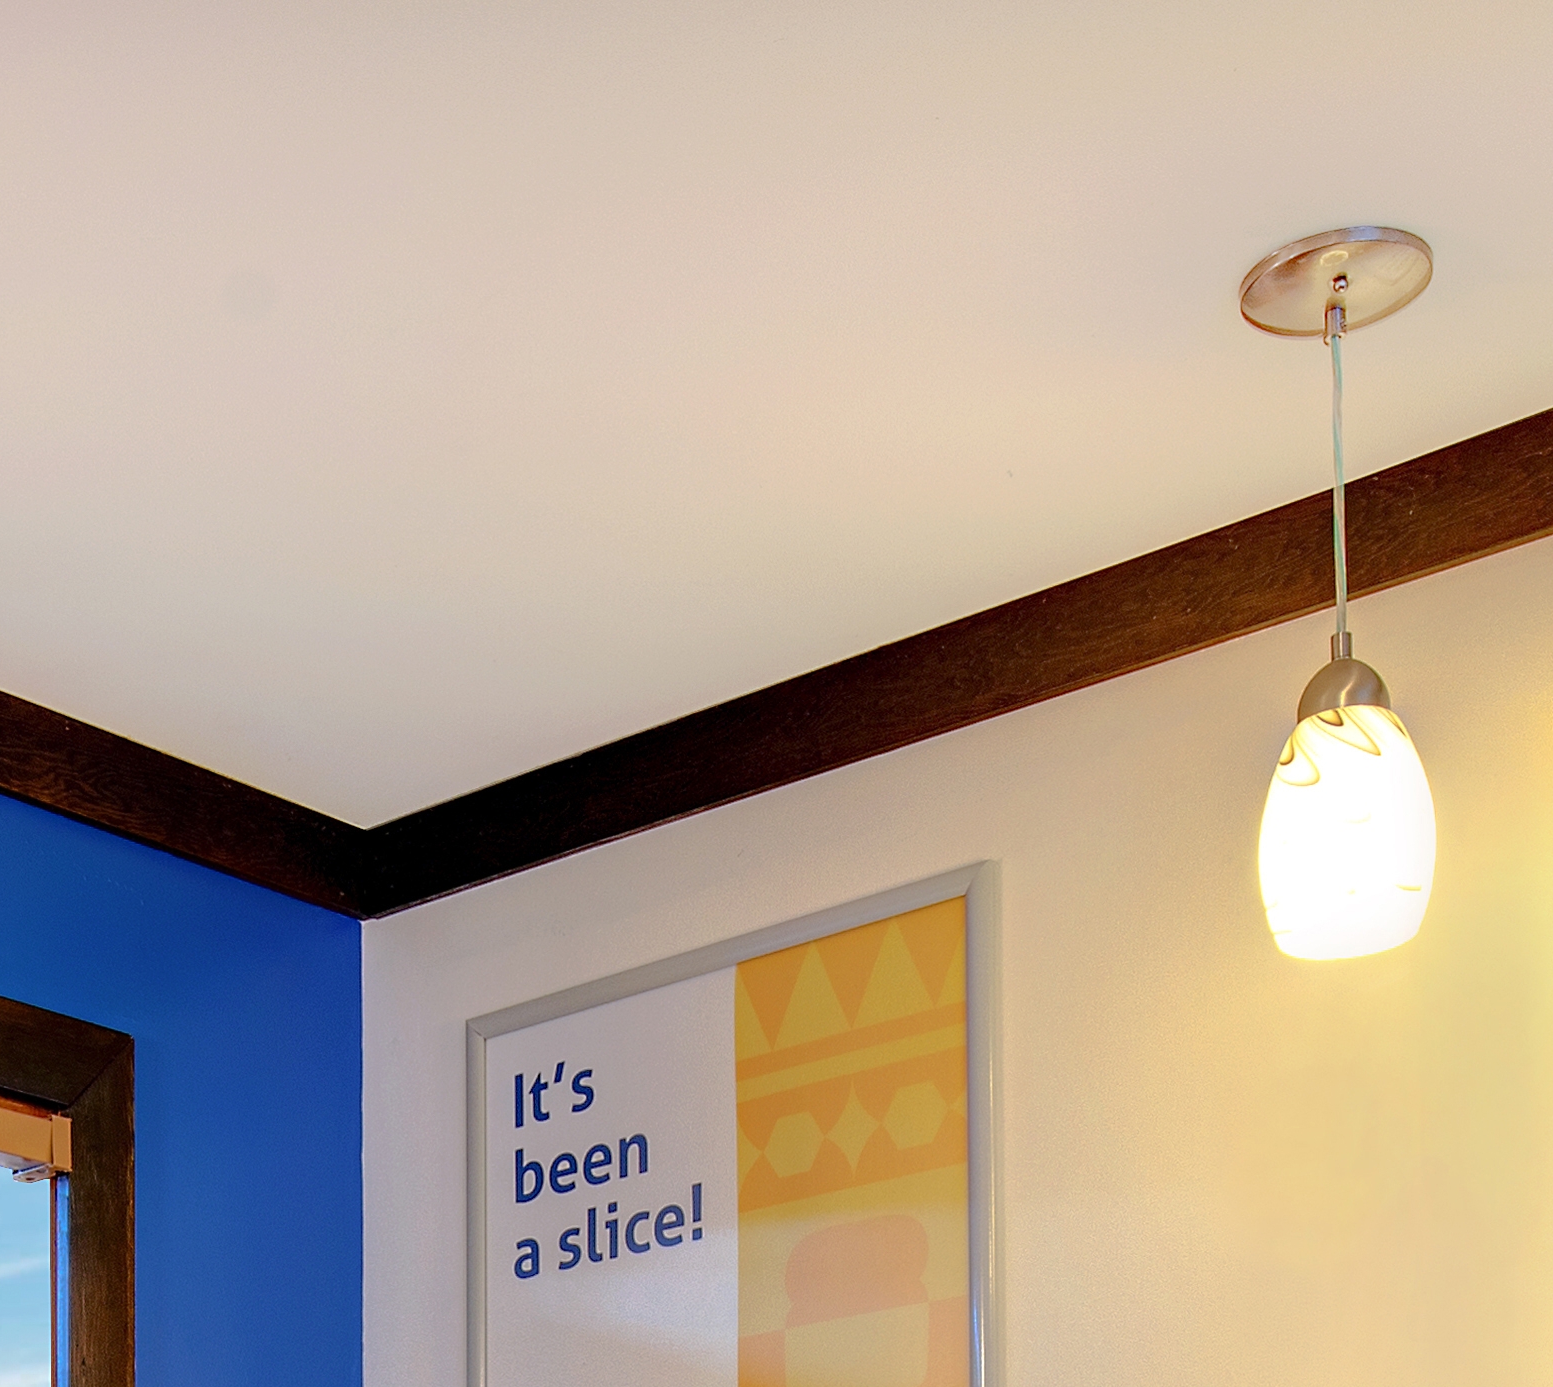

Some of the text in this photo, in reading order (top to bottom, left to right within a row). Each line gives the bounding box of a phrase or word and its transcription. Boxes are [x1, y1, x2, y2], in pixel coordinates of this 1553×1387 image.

[514, 1060, 595, 1128] It's
[515, 1133, 648, 1203] been
[514, 1183, 703, 1279] a slice!
